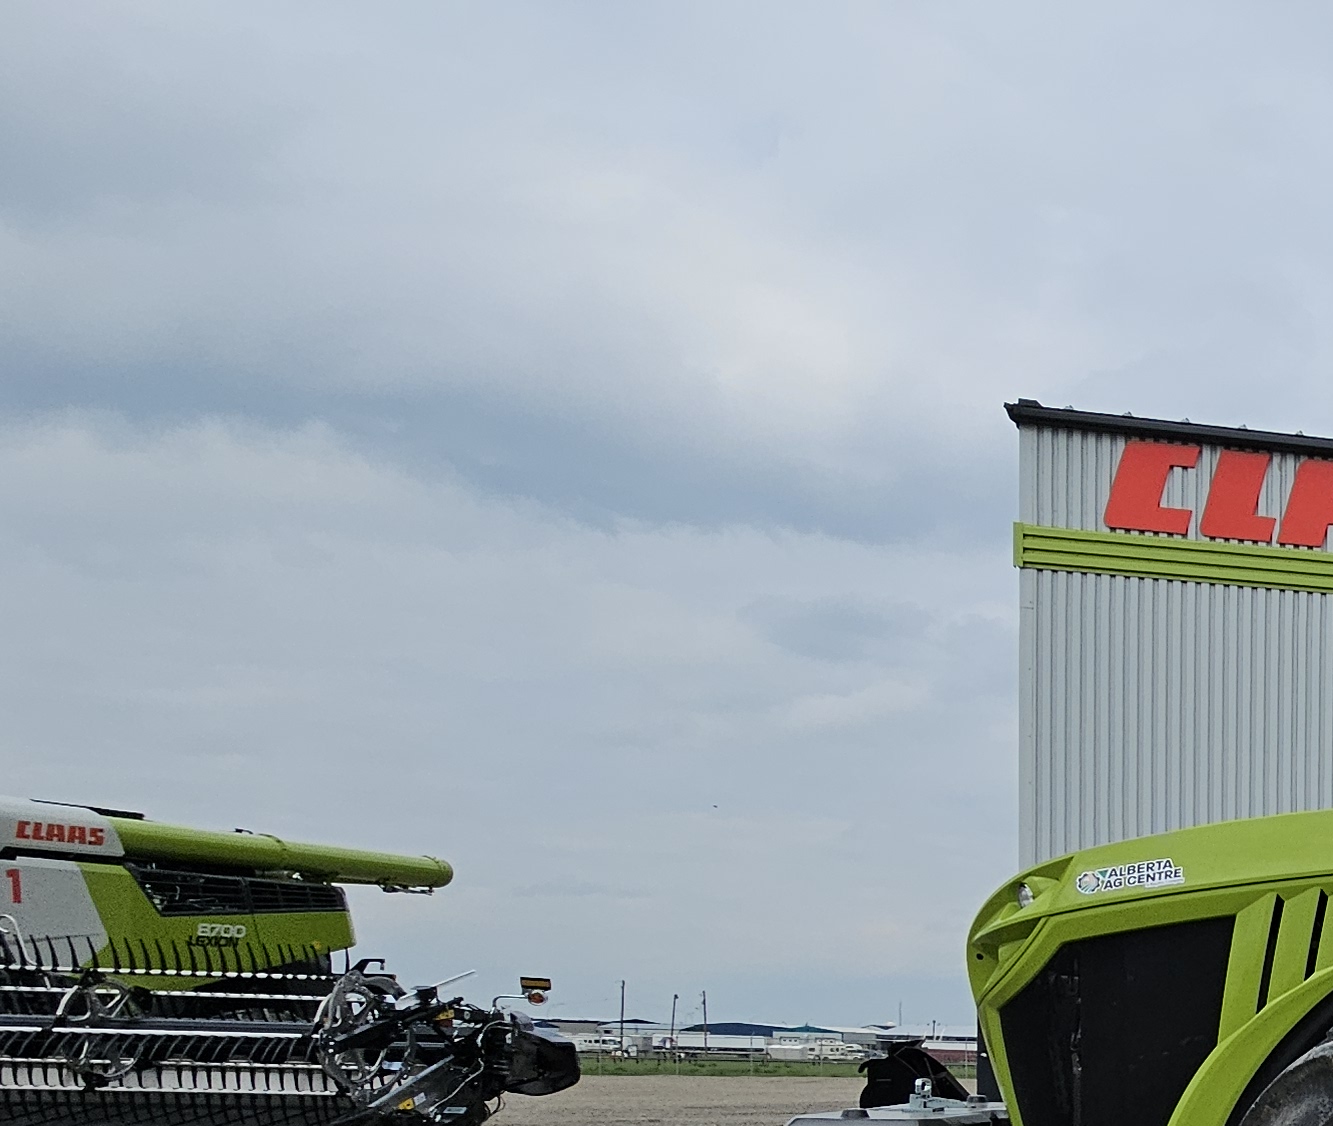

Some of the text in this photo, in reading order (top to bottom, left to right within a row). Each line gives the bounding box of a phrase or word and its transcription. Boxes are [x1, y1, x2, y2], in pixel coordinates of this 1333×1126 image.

[15, 820, 105, 846] CLAAS
[1103, 879, 1123, 891] AG
[1127, 868, 1182, 885] CENTRE
[1108, 859, 1173, 879] ALBERTA
[6, 868, 22, 903] 1
[197, 923, 246, 938] 8700
